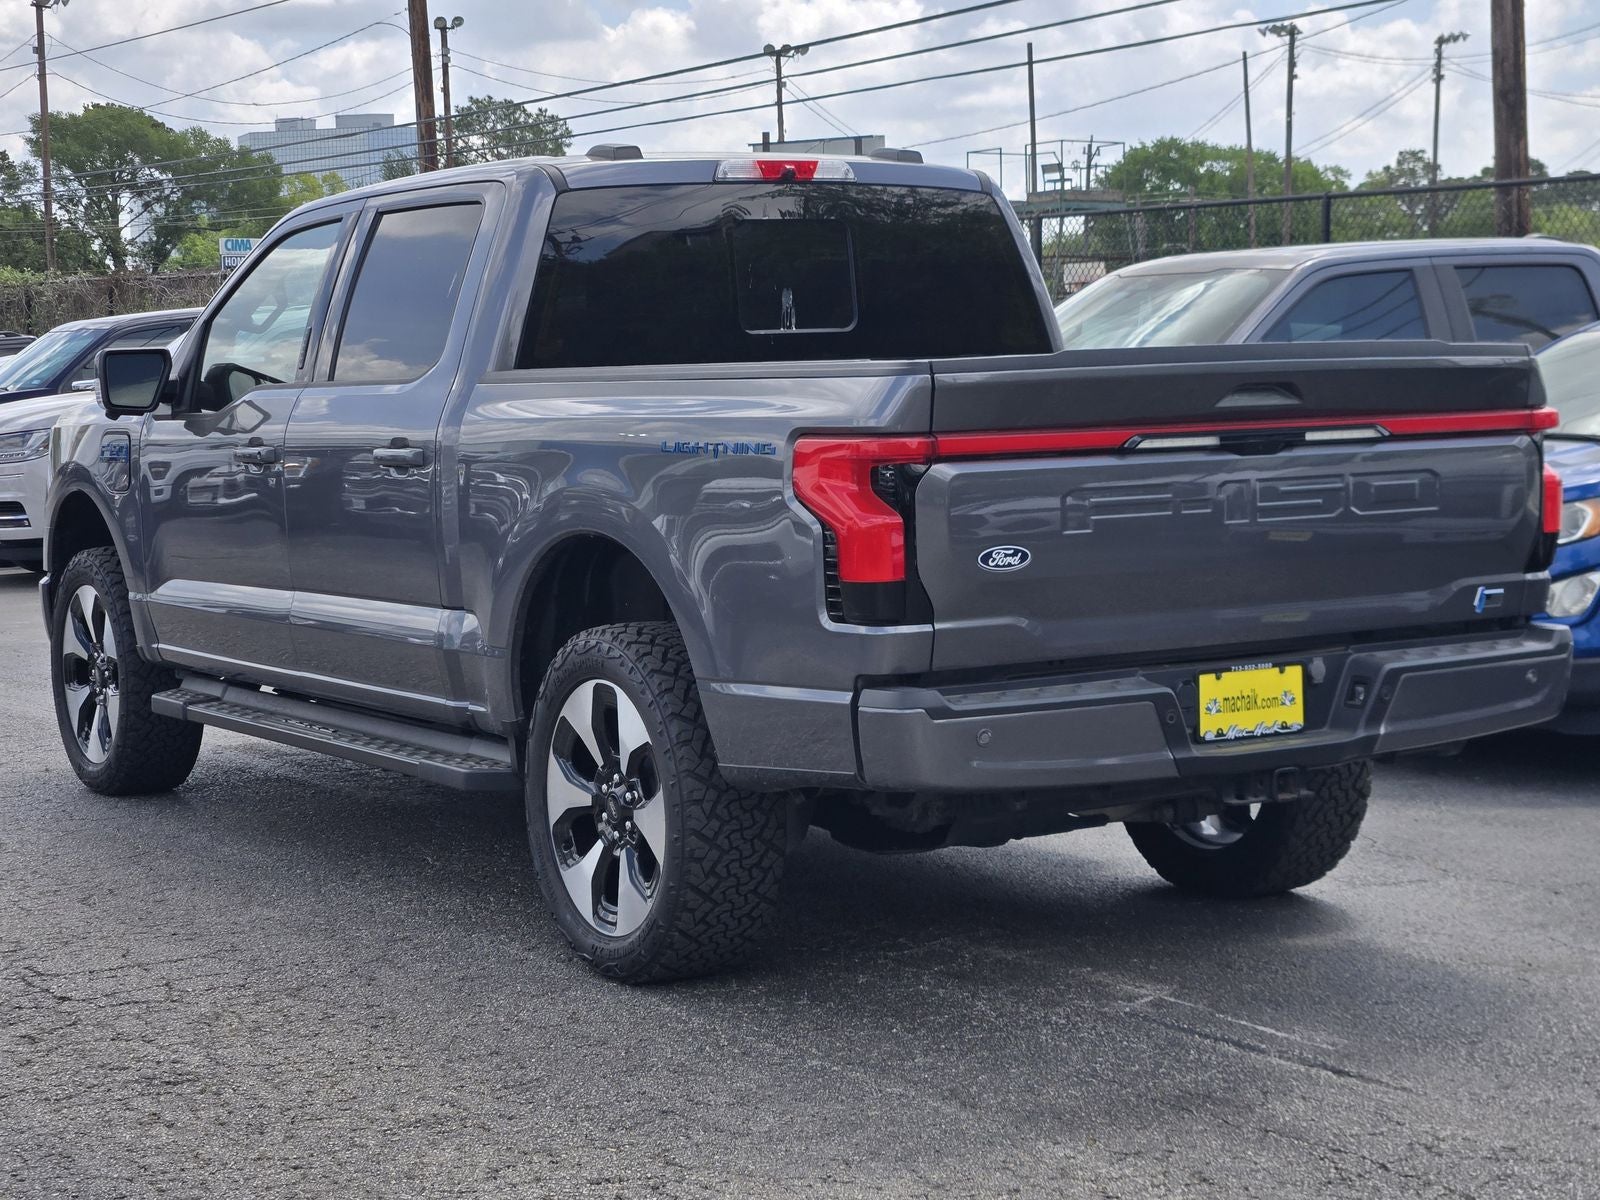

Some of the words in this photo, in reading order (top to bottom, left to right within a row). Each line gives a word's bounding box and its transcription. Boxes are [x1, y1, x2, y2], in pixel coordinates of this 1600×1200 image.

[224, 239, 252, 251] CIMA
[660, 441, 777, 459] LIGHTNING
[1060, 468, 1442, 535] F-150
[988, 549, 1022, 566] Ford
[1222, 689, 1280, 713] machaik.com
